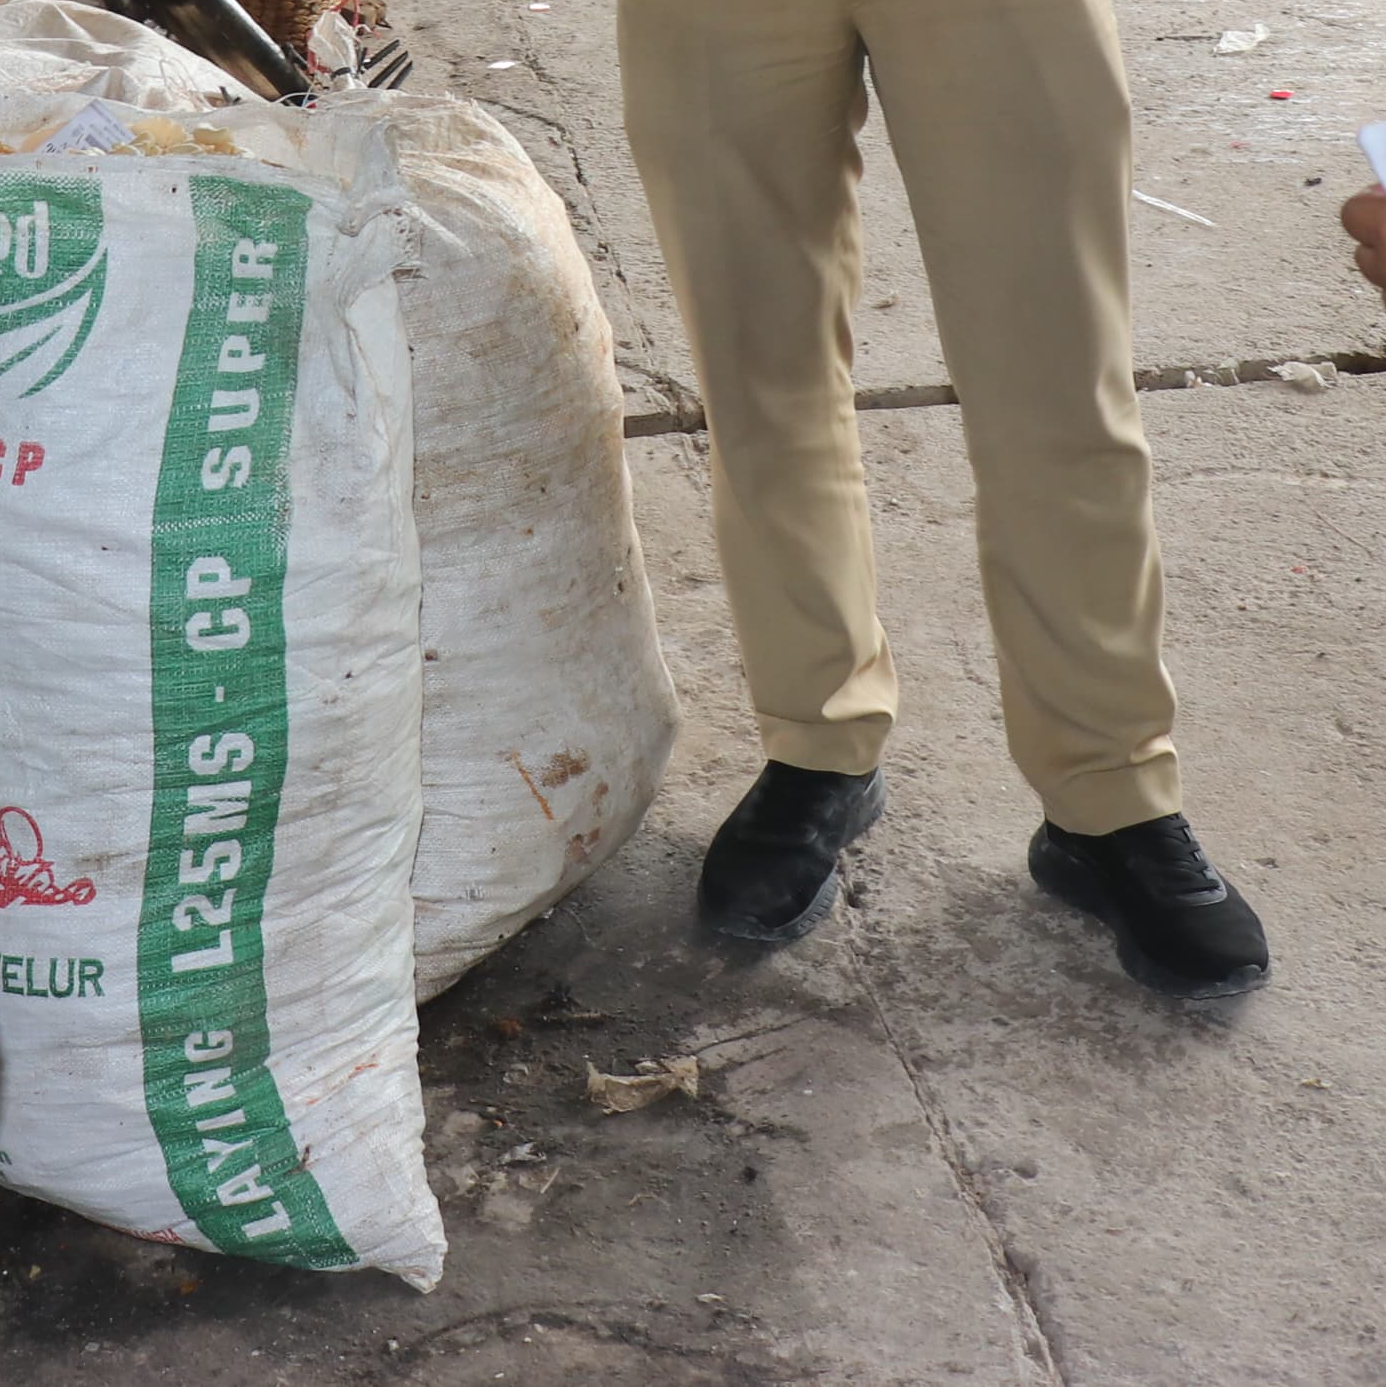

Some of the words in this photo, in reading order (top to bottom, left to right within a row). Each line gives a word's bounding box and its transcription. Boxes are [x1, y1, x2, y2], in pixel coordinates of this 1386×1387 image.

[200, 236, 279, 491] SUPER
[184, 555, 253, 652] CP
[170, 730, 255, 974] L25MS
[180, 1028, 292, 1238] LAYING
